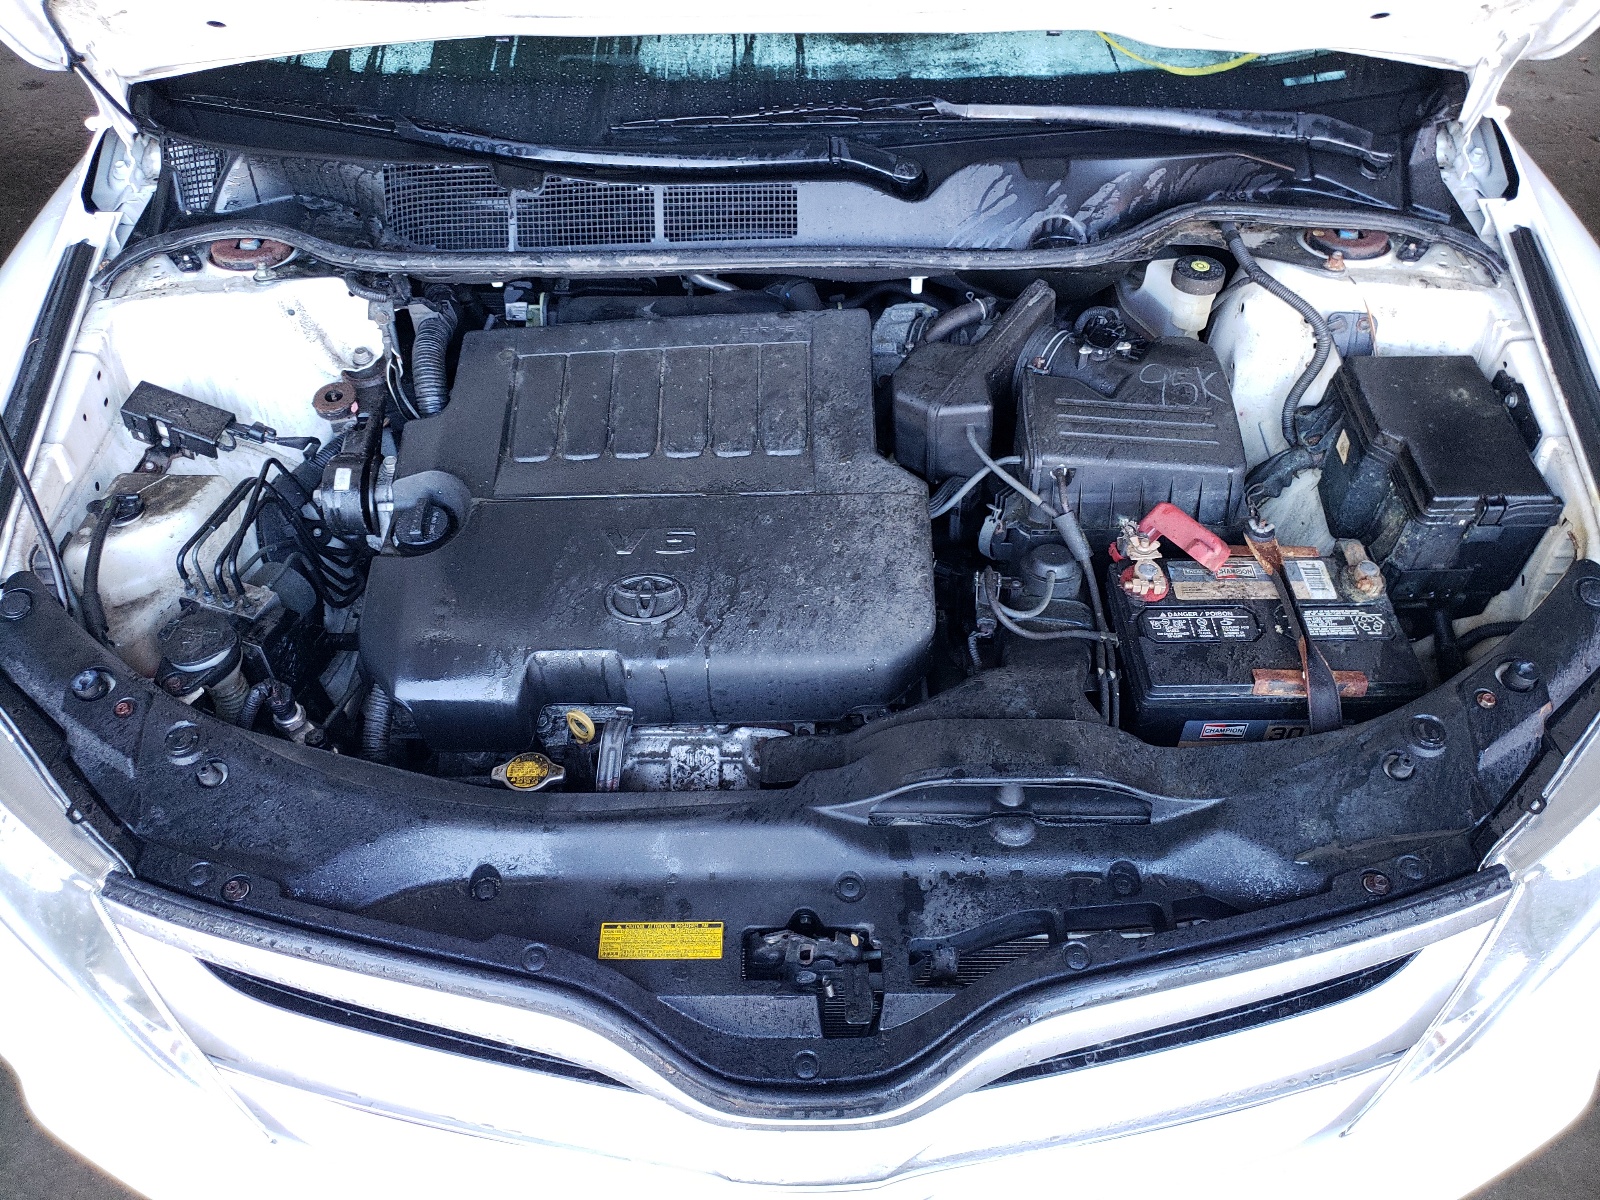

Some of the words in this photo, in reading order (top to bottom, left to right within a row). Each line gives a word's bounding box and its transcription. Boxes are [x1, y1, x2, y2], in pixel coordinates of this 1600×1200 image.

[1140, 363, 1227, 406] 95K
[601, 527, 697, 555] V6
[1217, 567, 1253, 576] CHAMPION
[1204, 727, 1244, 735] CHAMPION
[1269, 726, 1305, 741] 30
